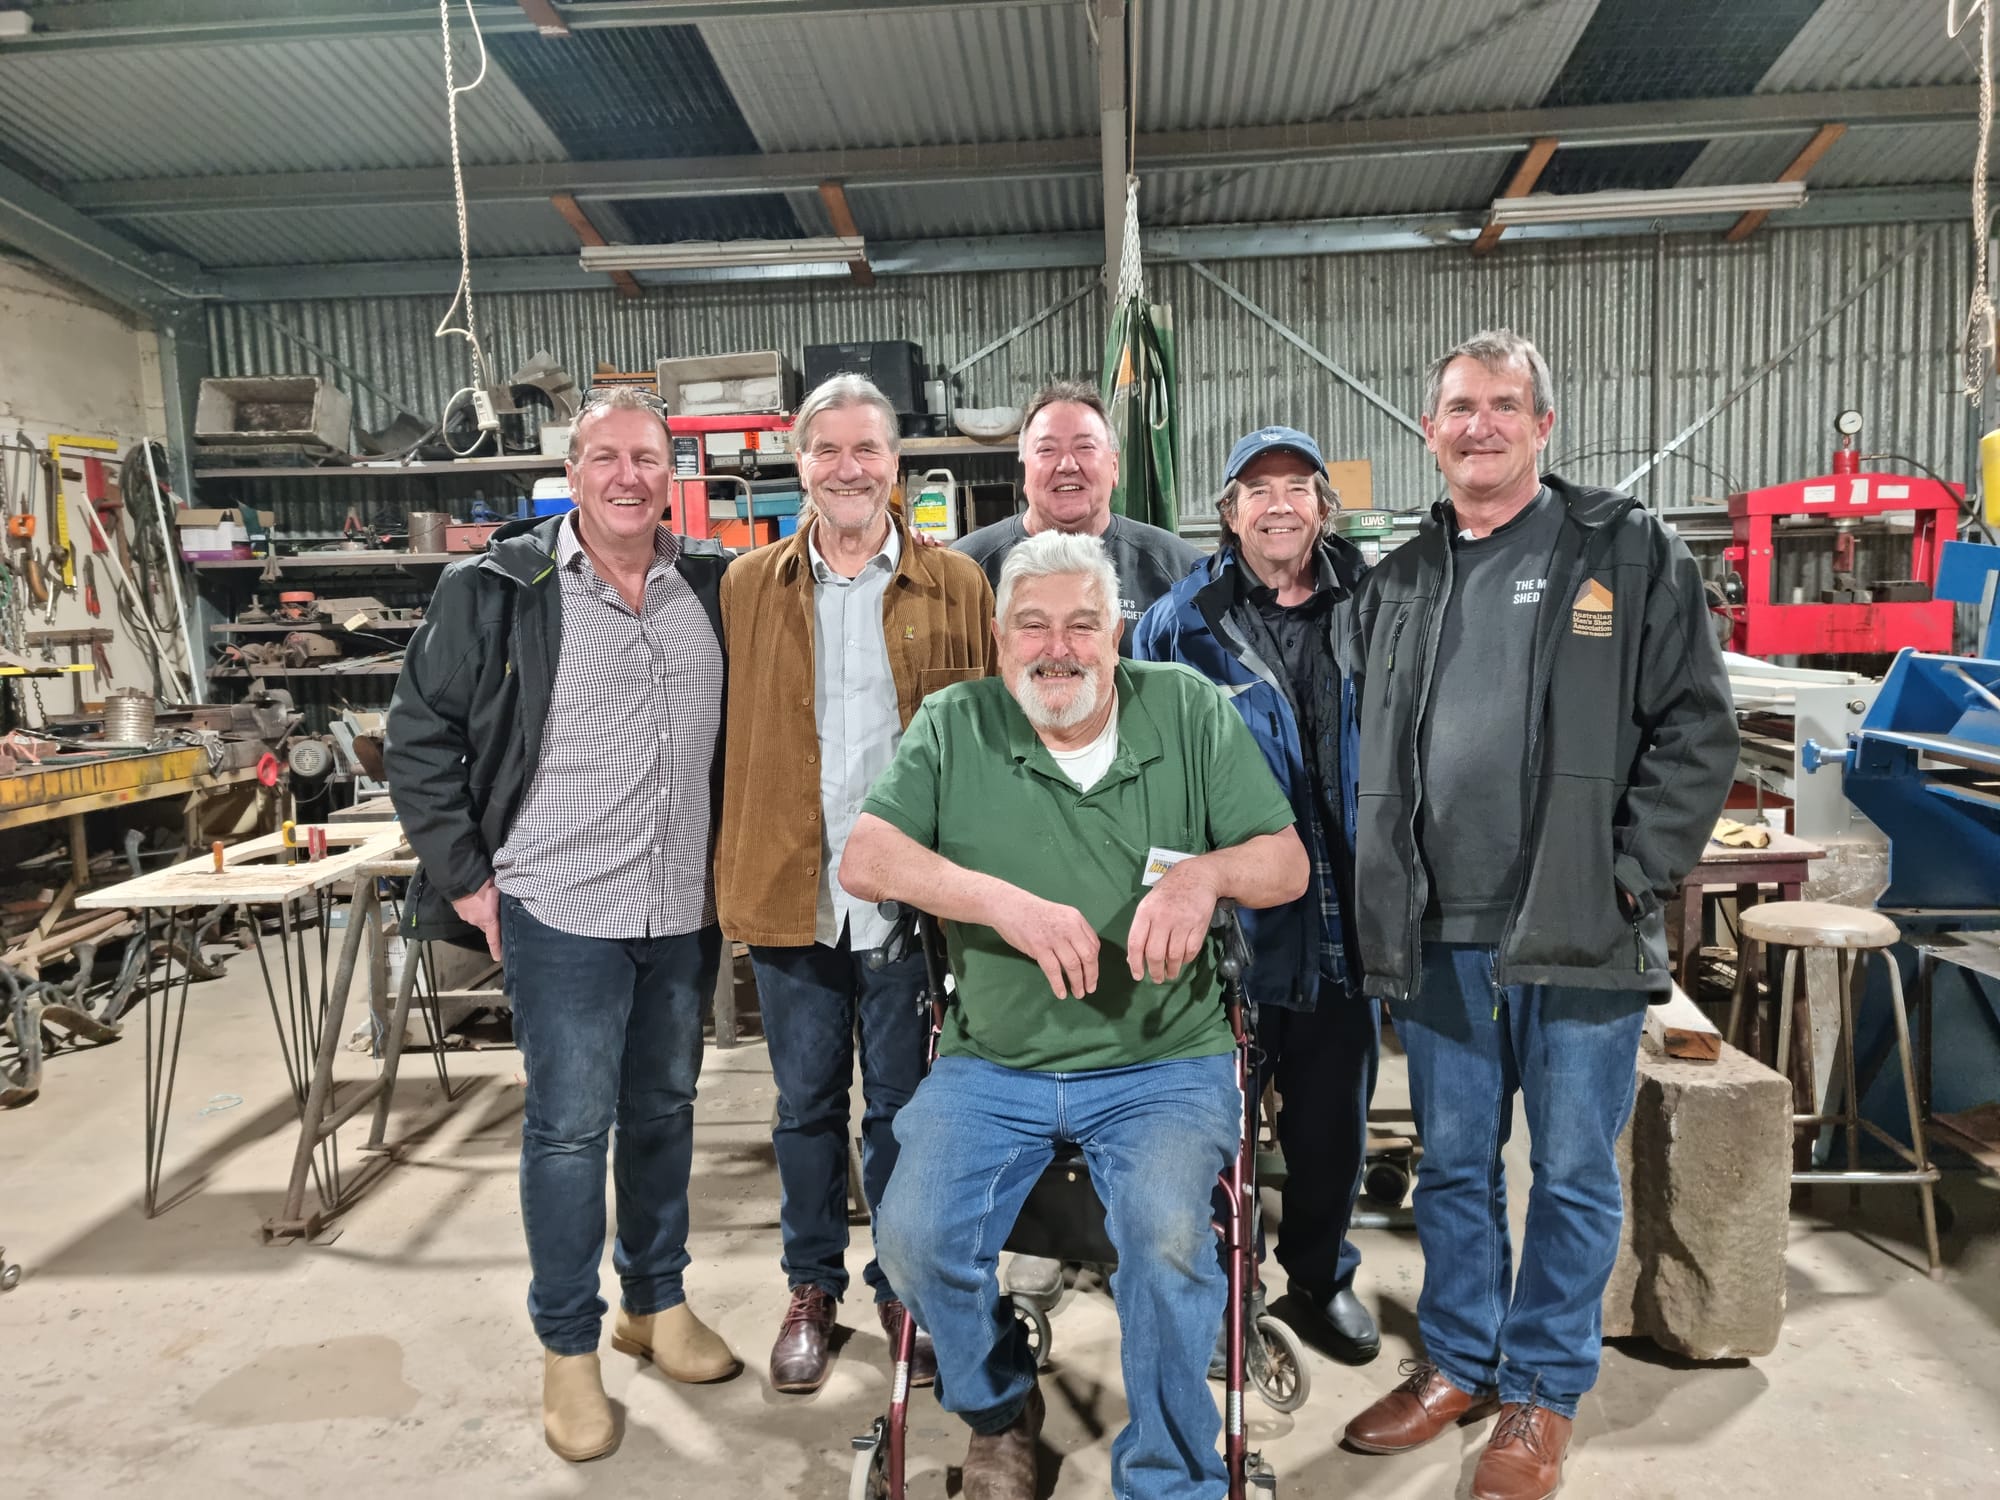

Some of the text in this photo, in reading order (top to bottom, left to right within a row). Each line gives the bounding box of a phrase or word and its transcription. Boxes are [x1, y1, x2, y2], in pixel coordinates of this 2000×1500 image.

[1515, 579, 1535, 591] THE
[1513, 592, 1540, 605] SHED
[1119, 599, 1135, 609] EN'S
[1122, 609, 1145, 620] OCIET
[1573, 610, 1612, 620] Australian
[1573, 622, 1612, 632] Association
